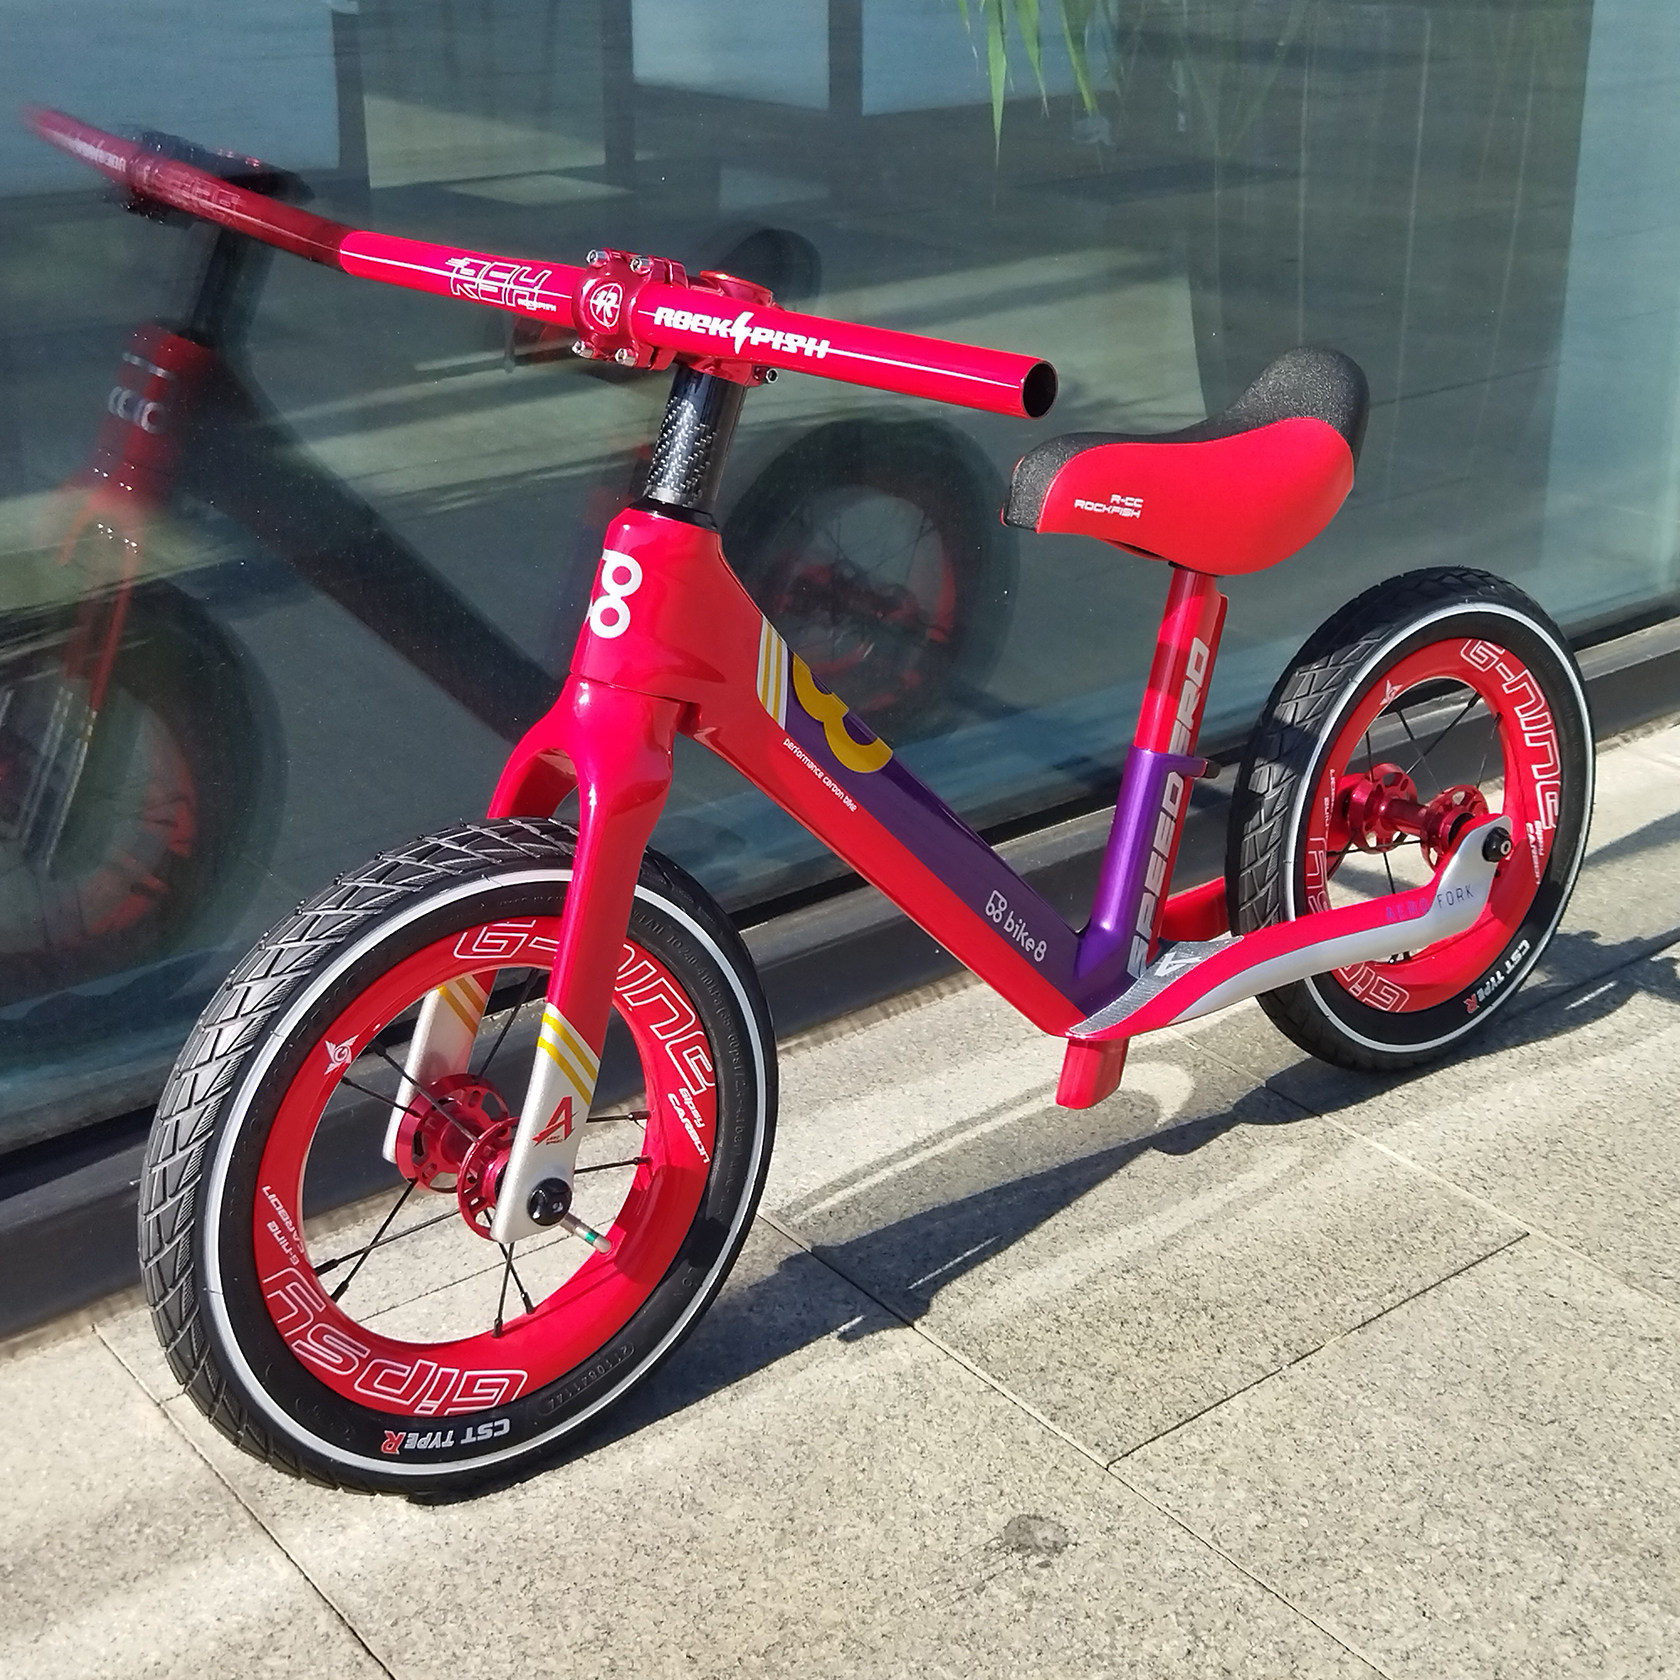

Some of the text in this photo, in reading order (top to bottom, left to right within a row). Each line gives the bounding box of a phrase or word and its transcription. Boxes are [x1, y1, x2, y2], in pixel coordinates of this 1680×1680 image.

[1074, 499, 1141, 519] ROCKFISH
[1110, 494, 1144, 508] R-CC
[783, 738, 858, 812] performance carbon bike
[1126, 771, 1185, 980] SPEED
[1437, 884, 1475, 909] FORK
[1504, 939, 1531, 975] CST
[667, 1093, 710, 1163] CARBON
[678, 1087, 706, 1128] Gipsy
[262, 1185, 305, 1254] CARBON
[262, 1267, 528, 1416] Gipsy
[460, 1418, 511, 1445] CST
